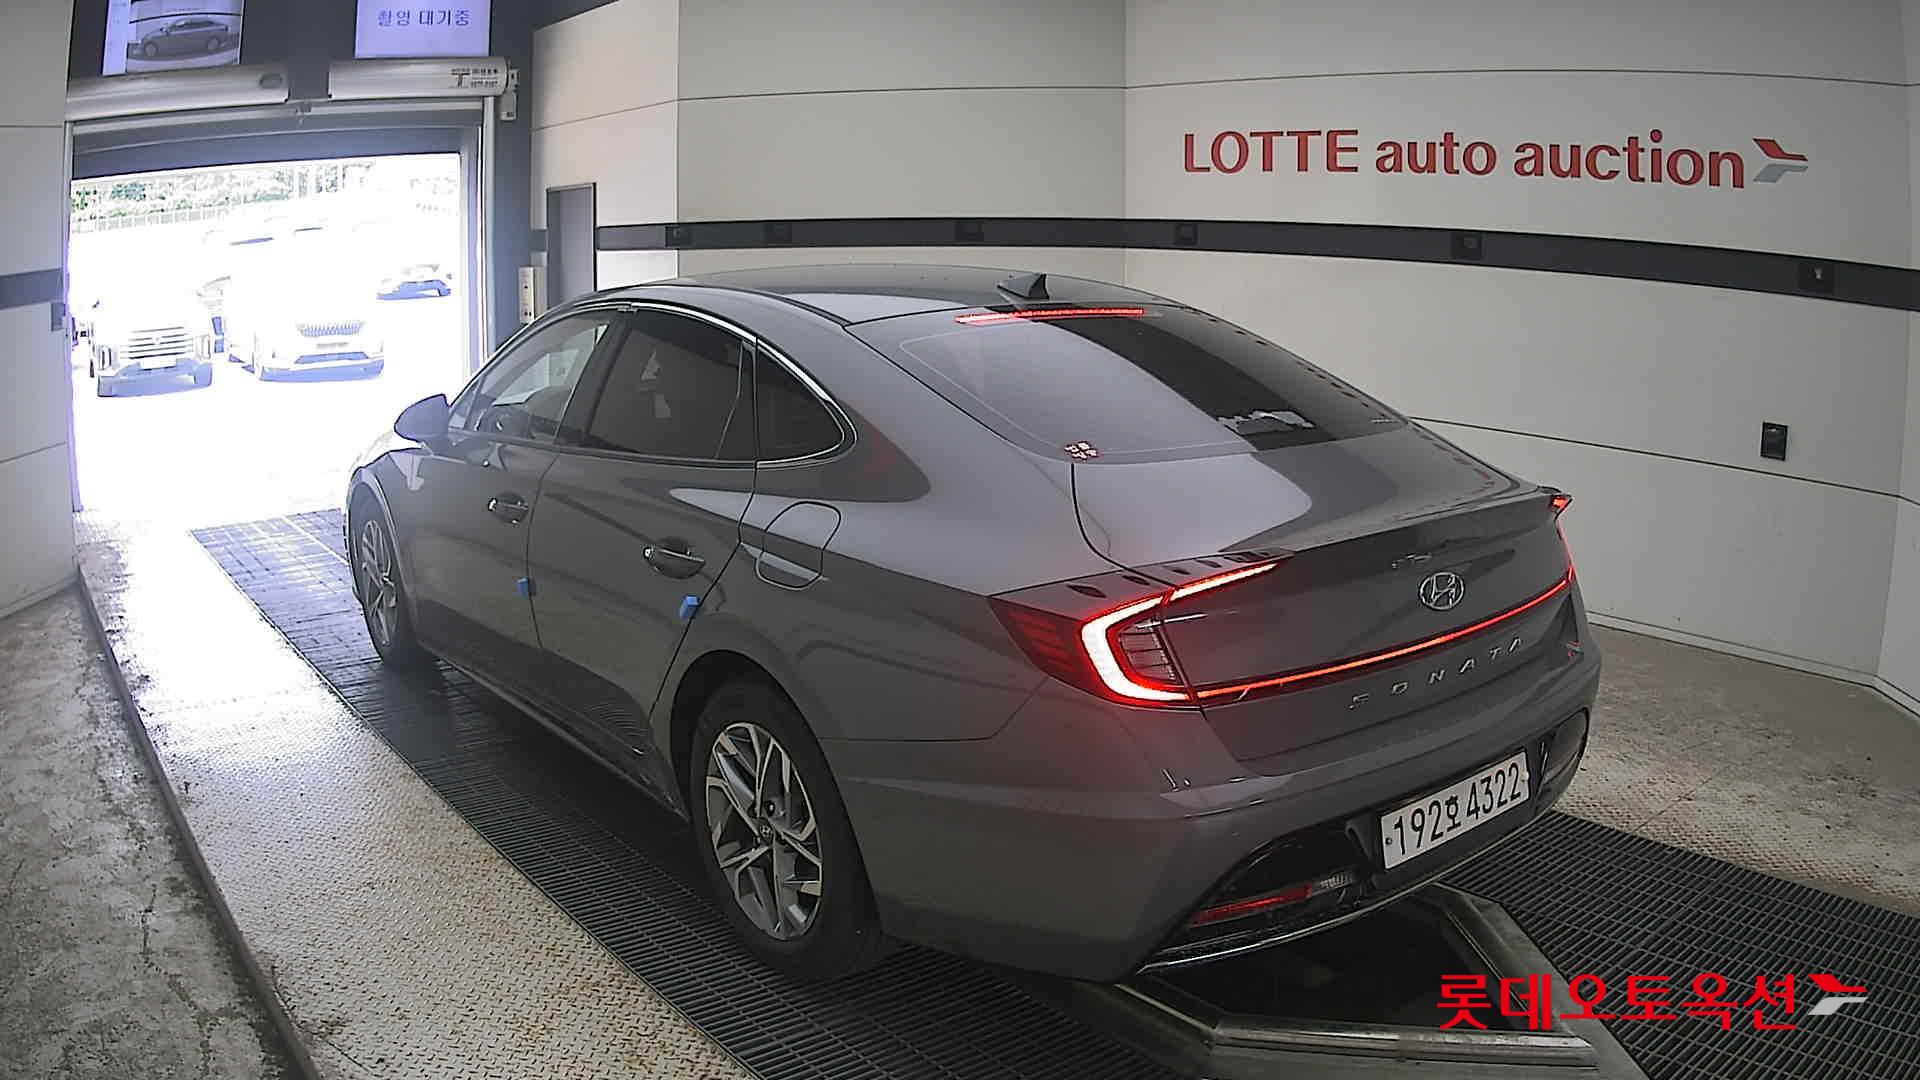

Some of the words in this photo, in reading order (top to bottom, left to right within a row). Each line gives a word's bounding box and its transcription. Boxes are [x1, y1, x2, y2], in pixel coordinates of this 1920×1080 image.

[419, 9, 470, 27] 대기중
[1183, 129, 1359, 174] LOTTE
[1375, 131, 1498, 177] auto
[1512, 128, 1745, 189] auction
[1466, 762, 1522, 820] 4322
